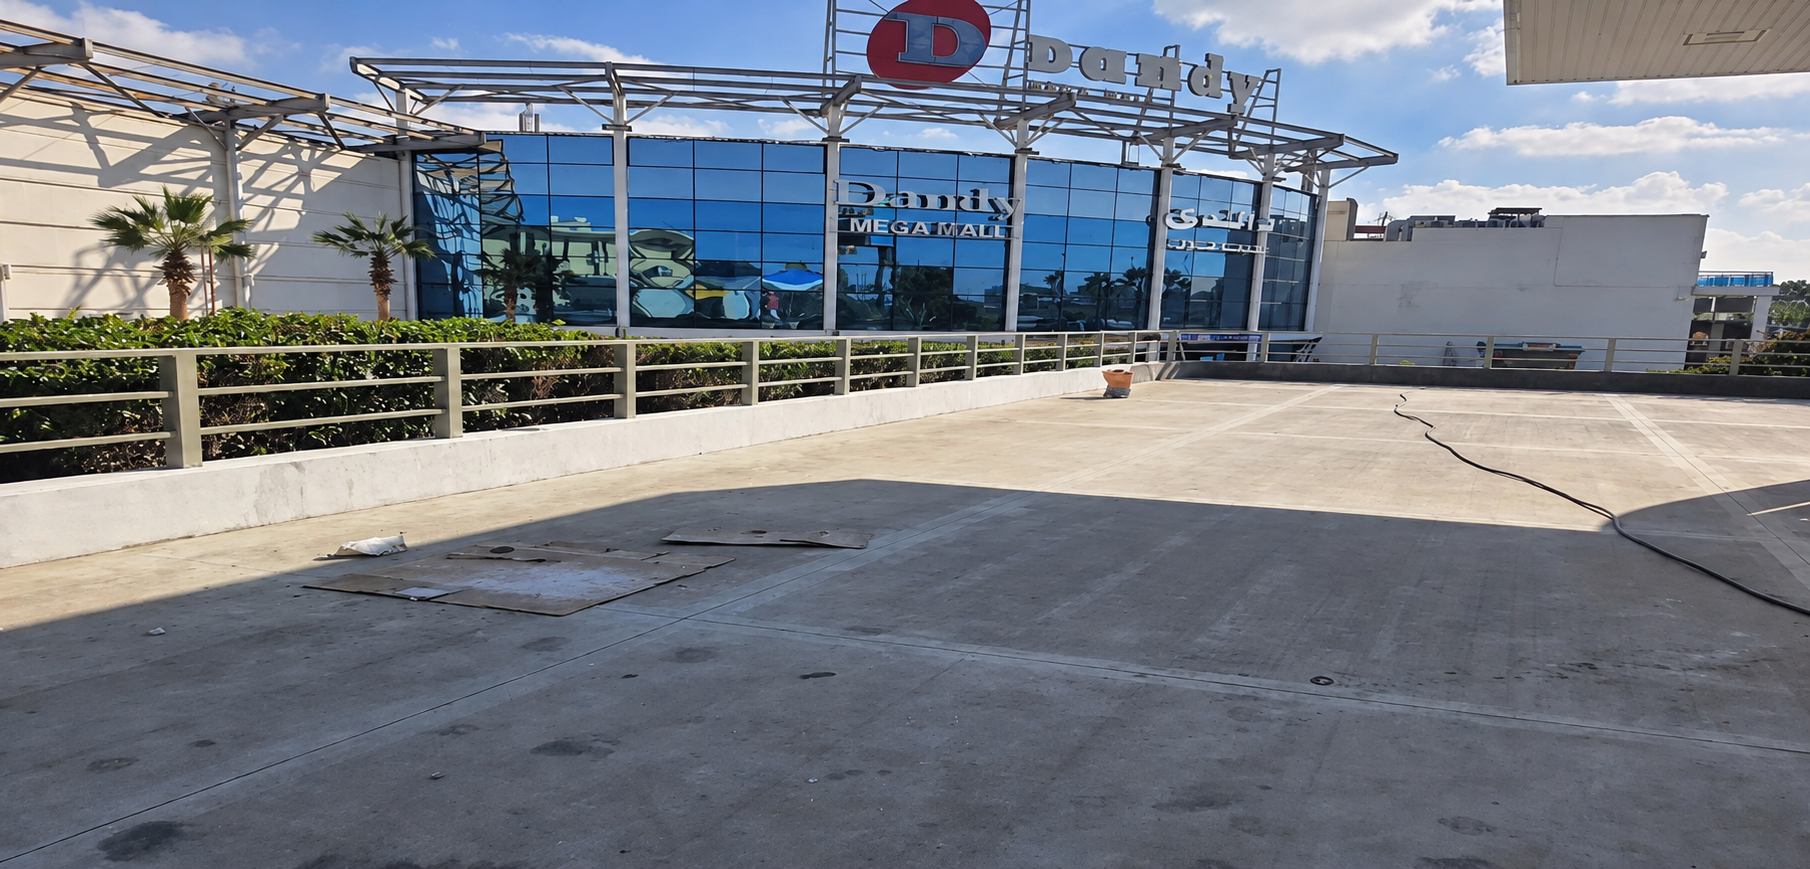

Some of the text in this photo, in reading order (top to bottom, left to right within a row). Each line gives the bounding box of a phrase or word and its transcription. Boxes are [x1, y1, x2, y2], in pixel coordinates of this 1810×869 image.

[884, 11, 986, 67] D
[1027, 34, 1261, 115] Dandy
[833, 179, 1021, 221] Dandy
[850, 217, 1007, 239] MEGA MALL
